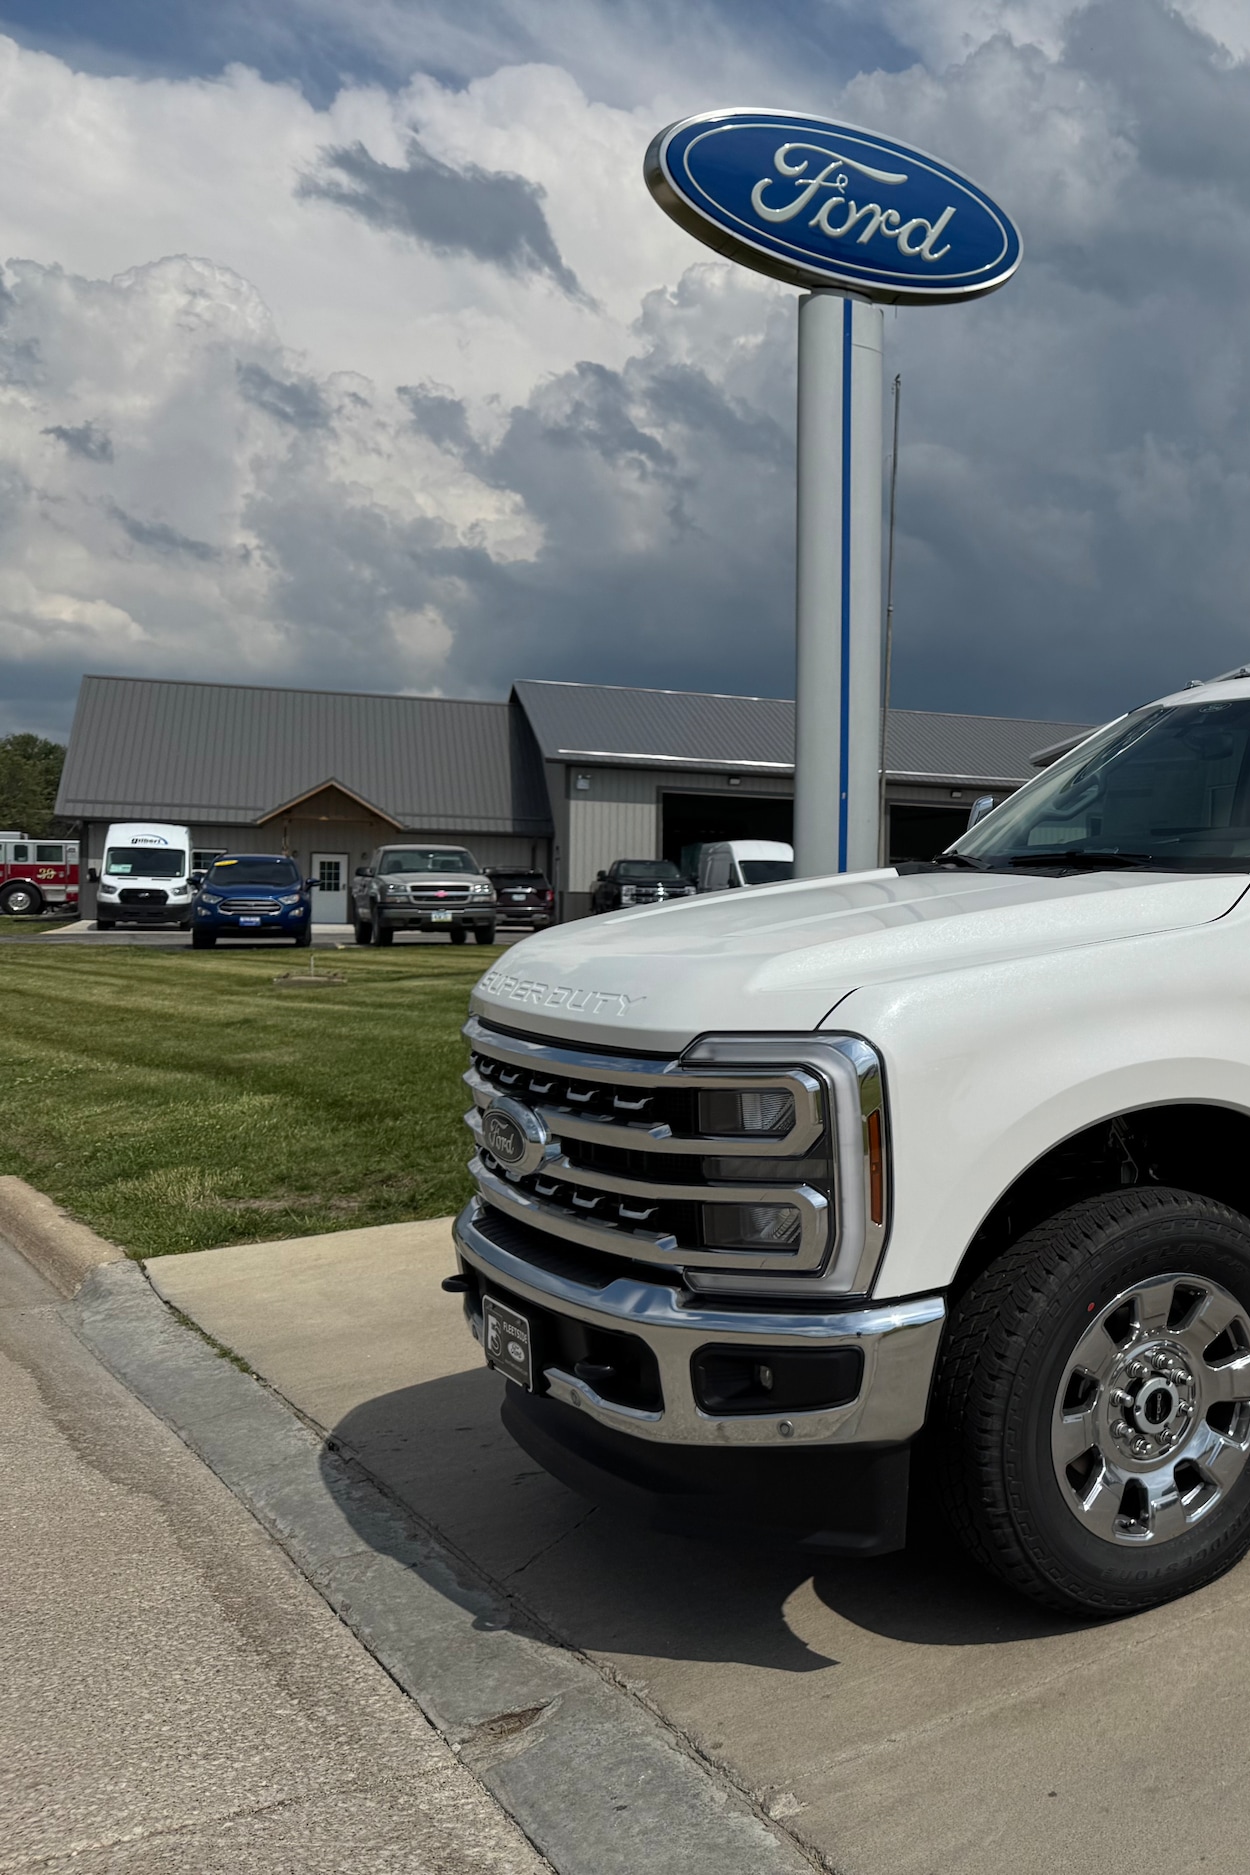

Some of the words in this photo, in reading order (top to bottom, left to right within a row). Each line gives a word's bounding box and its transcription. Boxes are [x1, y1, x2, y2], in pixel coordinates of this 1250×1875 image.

[751, 143, 956, 262] Ford
[479, 971, 549, 1005] SUPER
[544, 986, 647, 1017] DUTY
[488, 1118, 516, 1155] Ford
